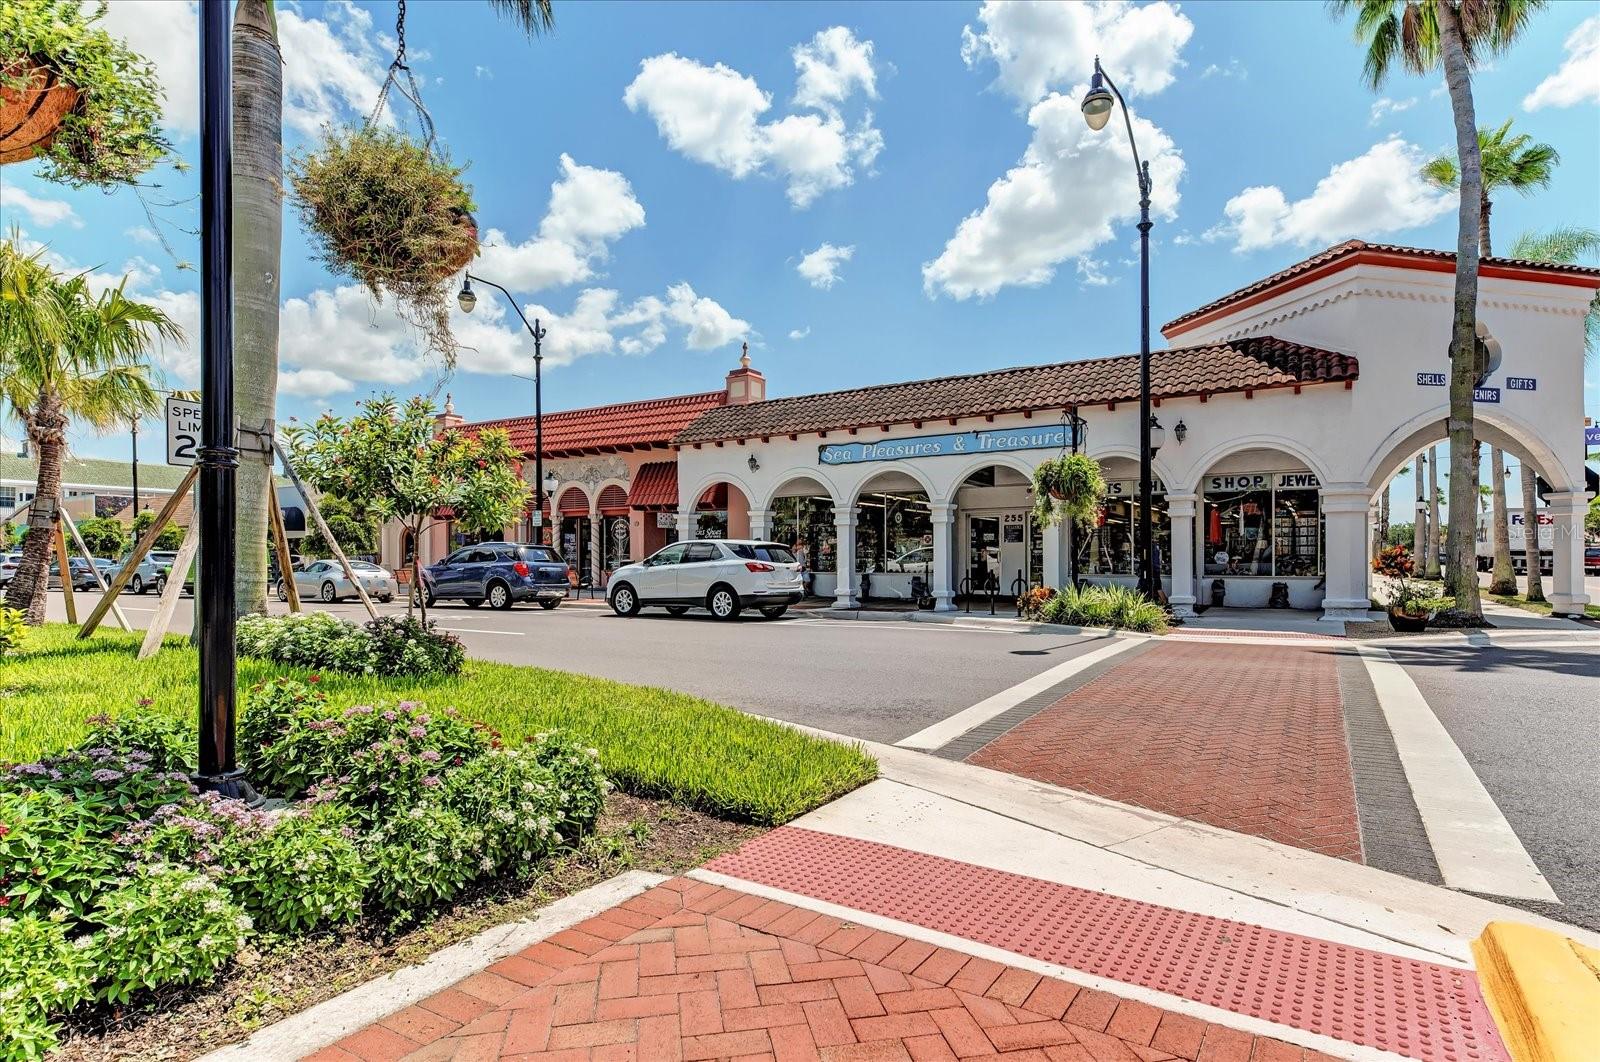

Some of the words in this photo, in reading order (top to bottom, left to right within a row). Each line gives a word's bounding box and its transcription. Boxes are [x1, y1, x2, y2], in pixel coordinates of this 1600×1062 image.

[1417, 375, 1446, 385] SHELLS
[1510, 379, 1534, 389] GIFTS
[1472, 389, 1498, 401] ENIRS
[172, 406, 201, 420] SPE
[178, 421, 202, 432] LIM
[175, 434, 197, 459] 2
[824, 447, 851, 461] Sea
[862, 442, 942, 459] Pleasures
[953, 436, 966, 451] &
[1212, 475, 1264, 489] SHOP
[1279, 474, 1320, 487] JEWE
[1004, 514, 1023, 523] 255
[1511, 514, 1554, 525] FeEx
